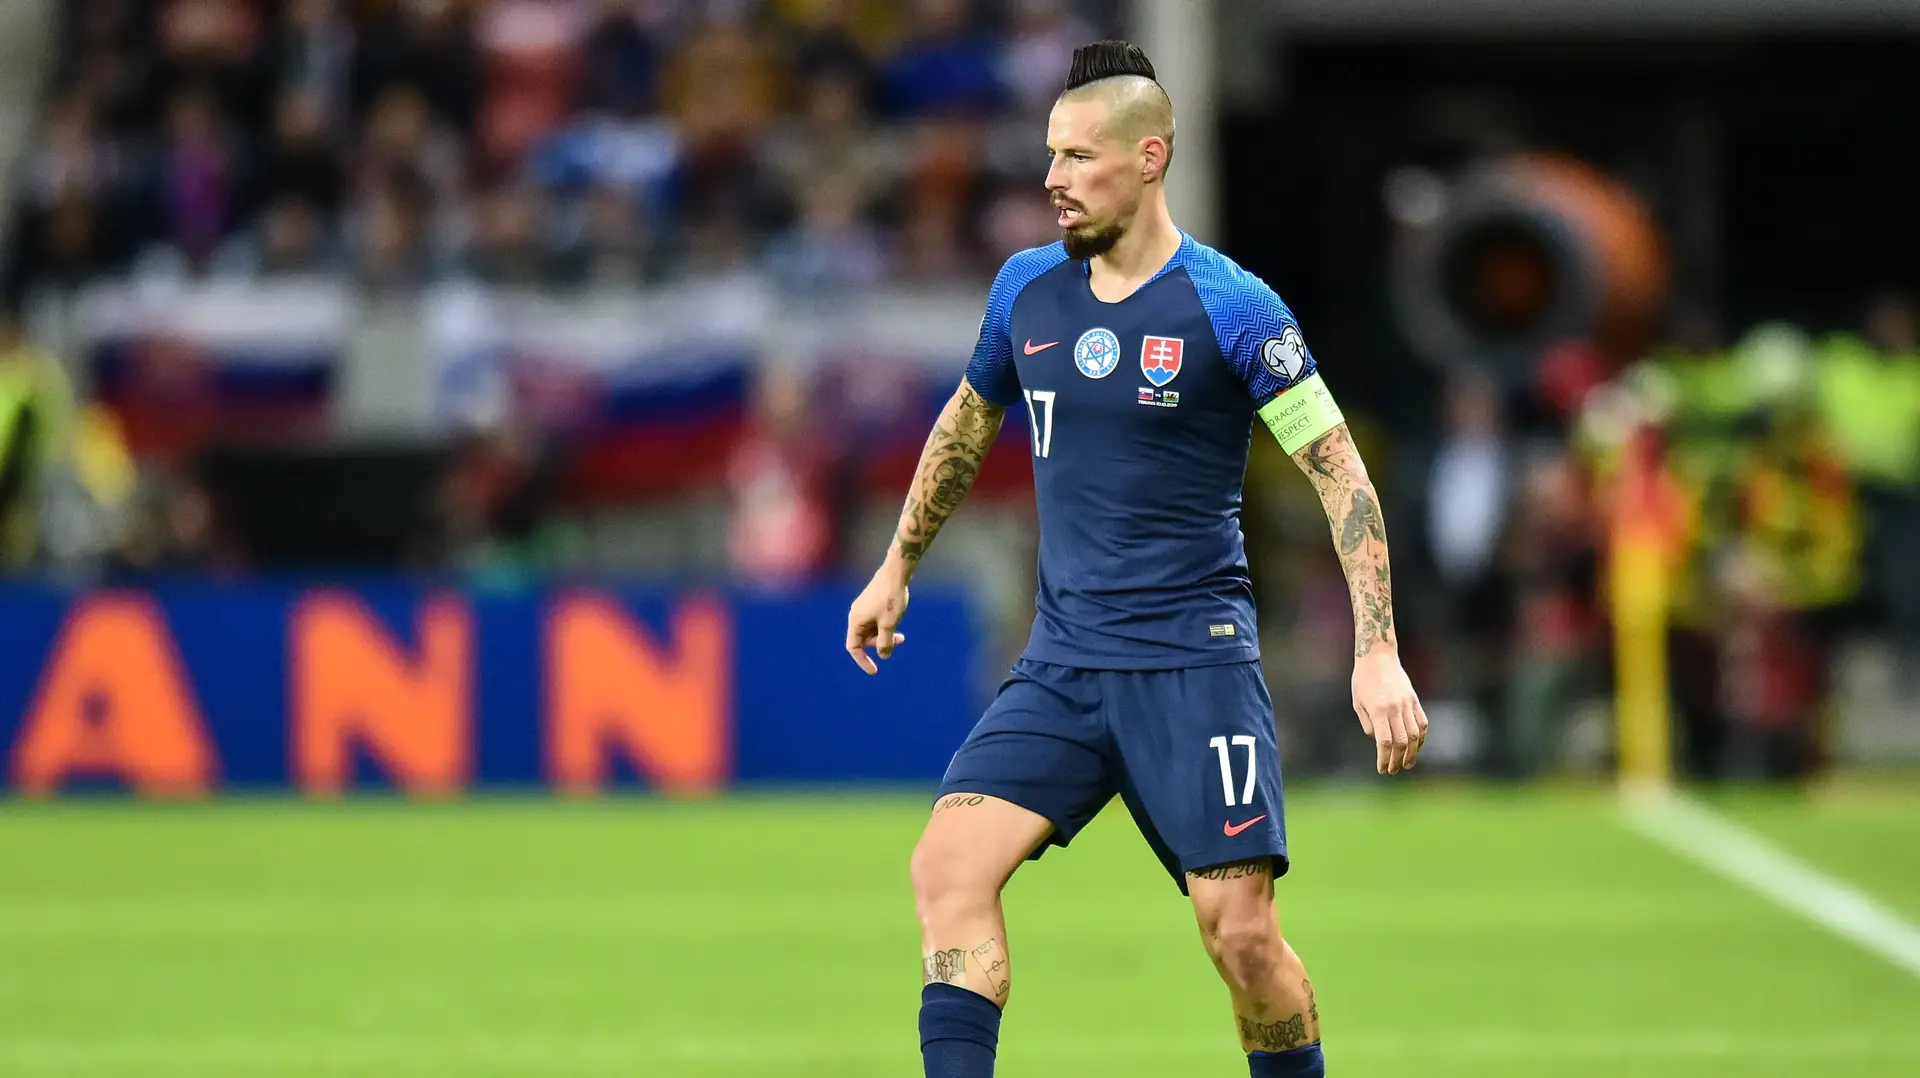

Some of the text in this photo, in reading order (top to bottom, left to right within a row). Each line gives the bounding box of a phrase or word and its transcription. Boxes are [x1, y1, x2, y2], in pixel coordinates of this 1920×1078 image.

[1023, 389, 1056, 459] 17
[1274, 398, 1307, 421] RACISM
[9, 587, 735, 795] ANN
[1209, 735, 1256, 806] 17
